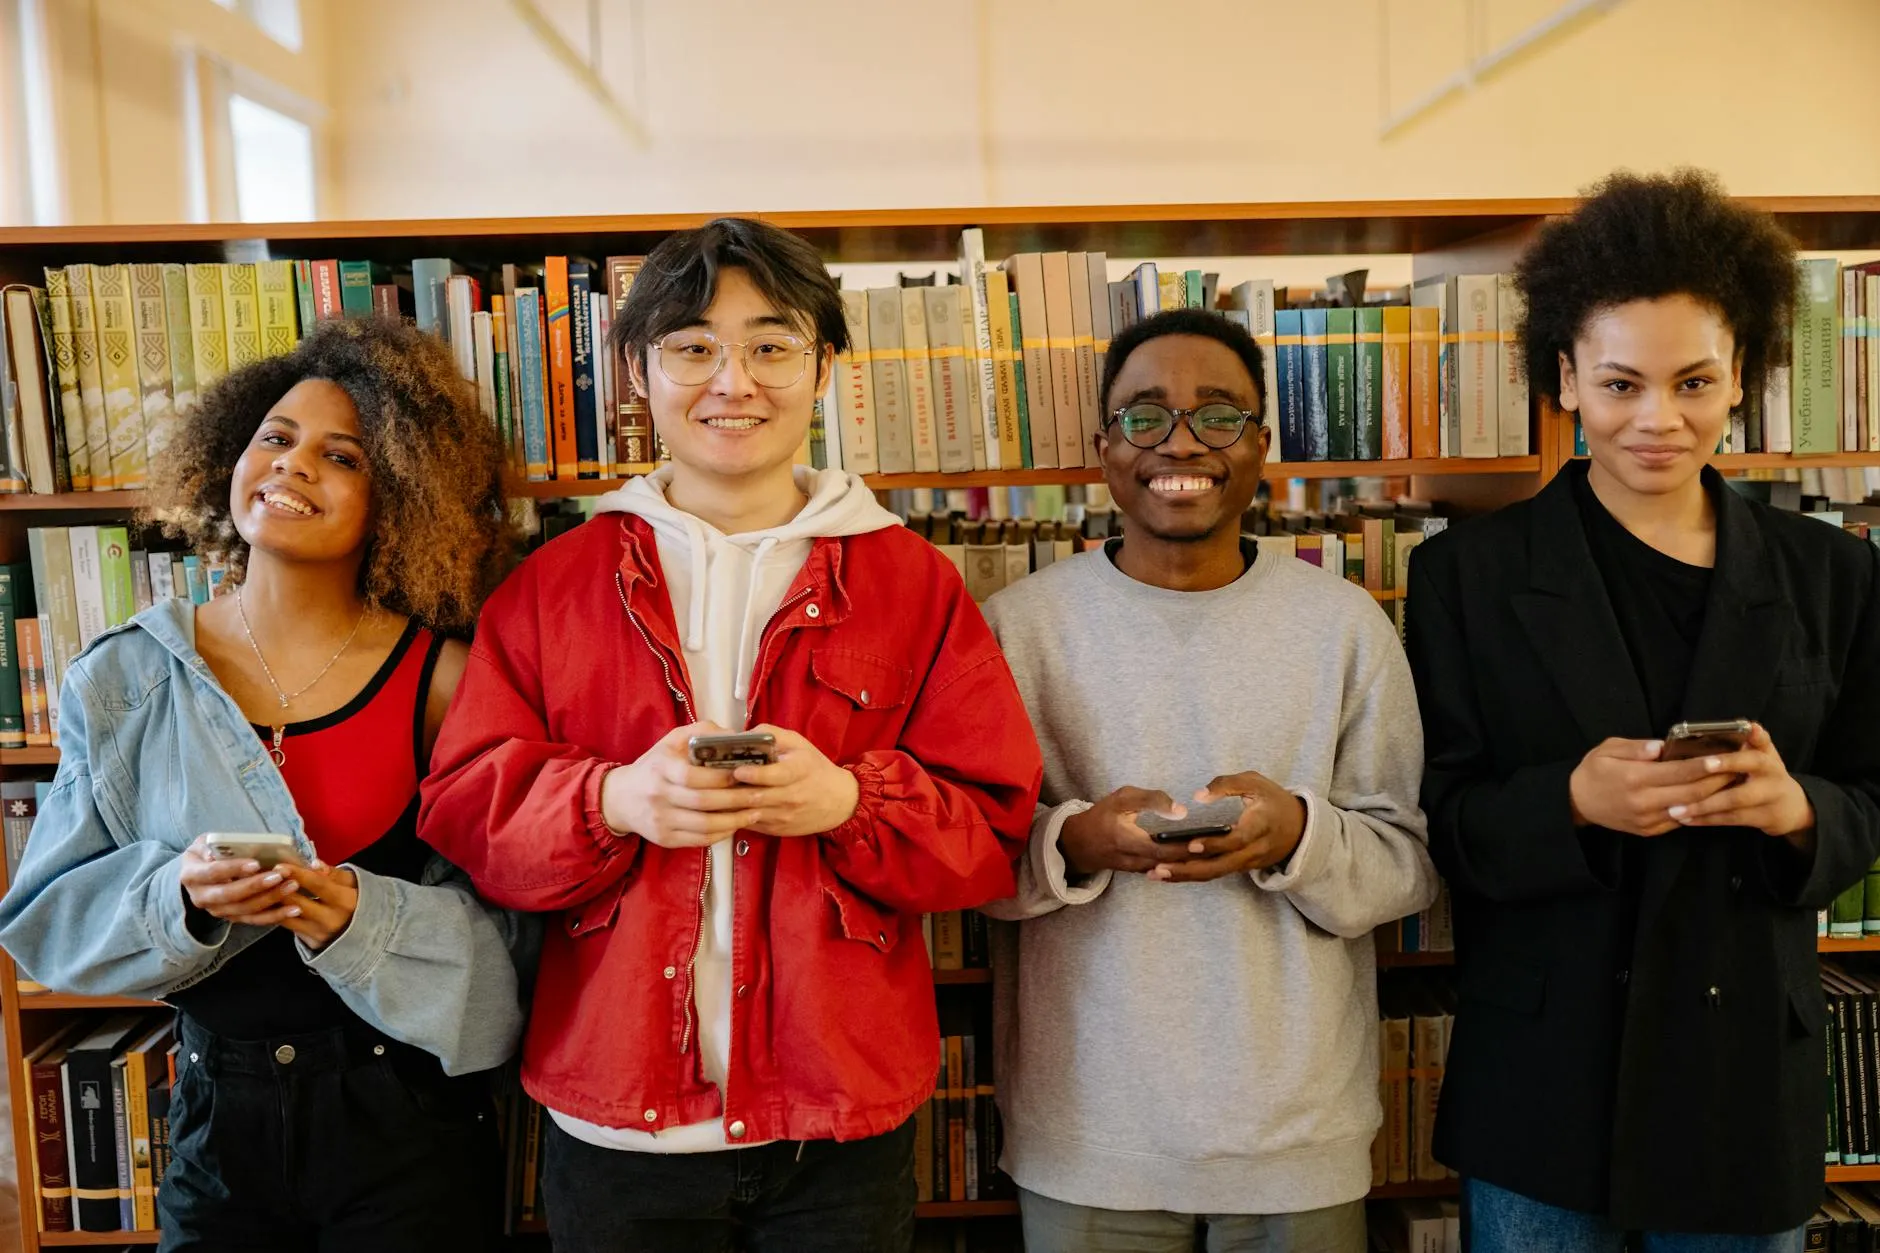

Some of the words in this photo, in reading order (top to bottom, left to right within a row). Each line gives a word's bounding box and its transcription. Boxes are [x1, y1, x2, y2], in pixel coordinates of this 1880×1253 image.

[83, 350, 90, 360] 5
[113, 350, 120, 361] 6
[981, 337, 996, 391] БАЦЬАЎ
[1820, 317, 1832, 389] издания
[852, 363, 865, 409] БАЛАД
